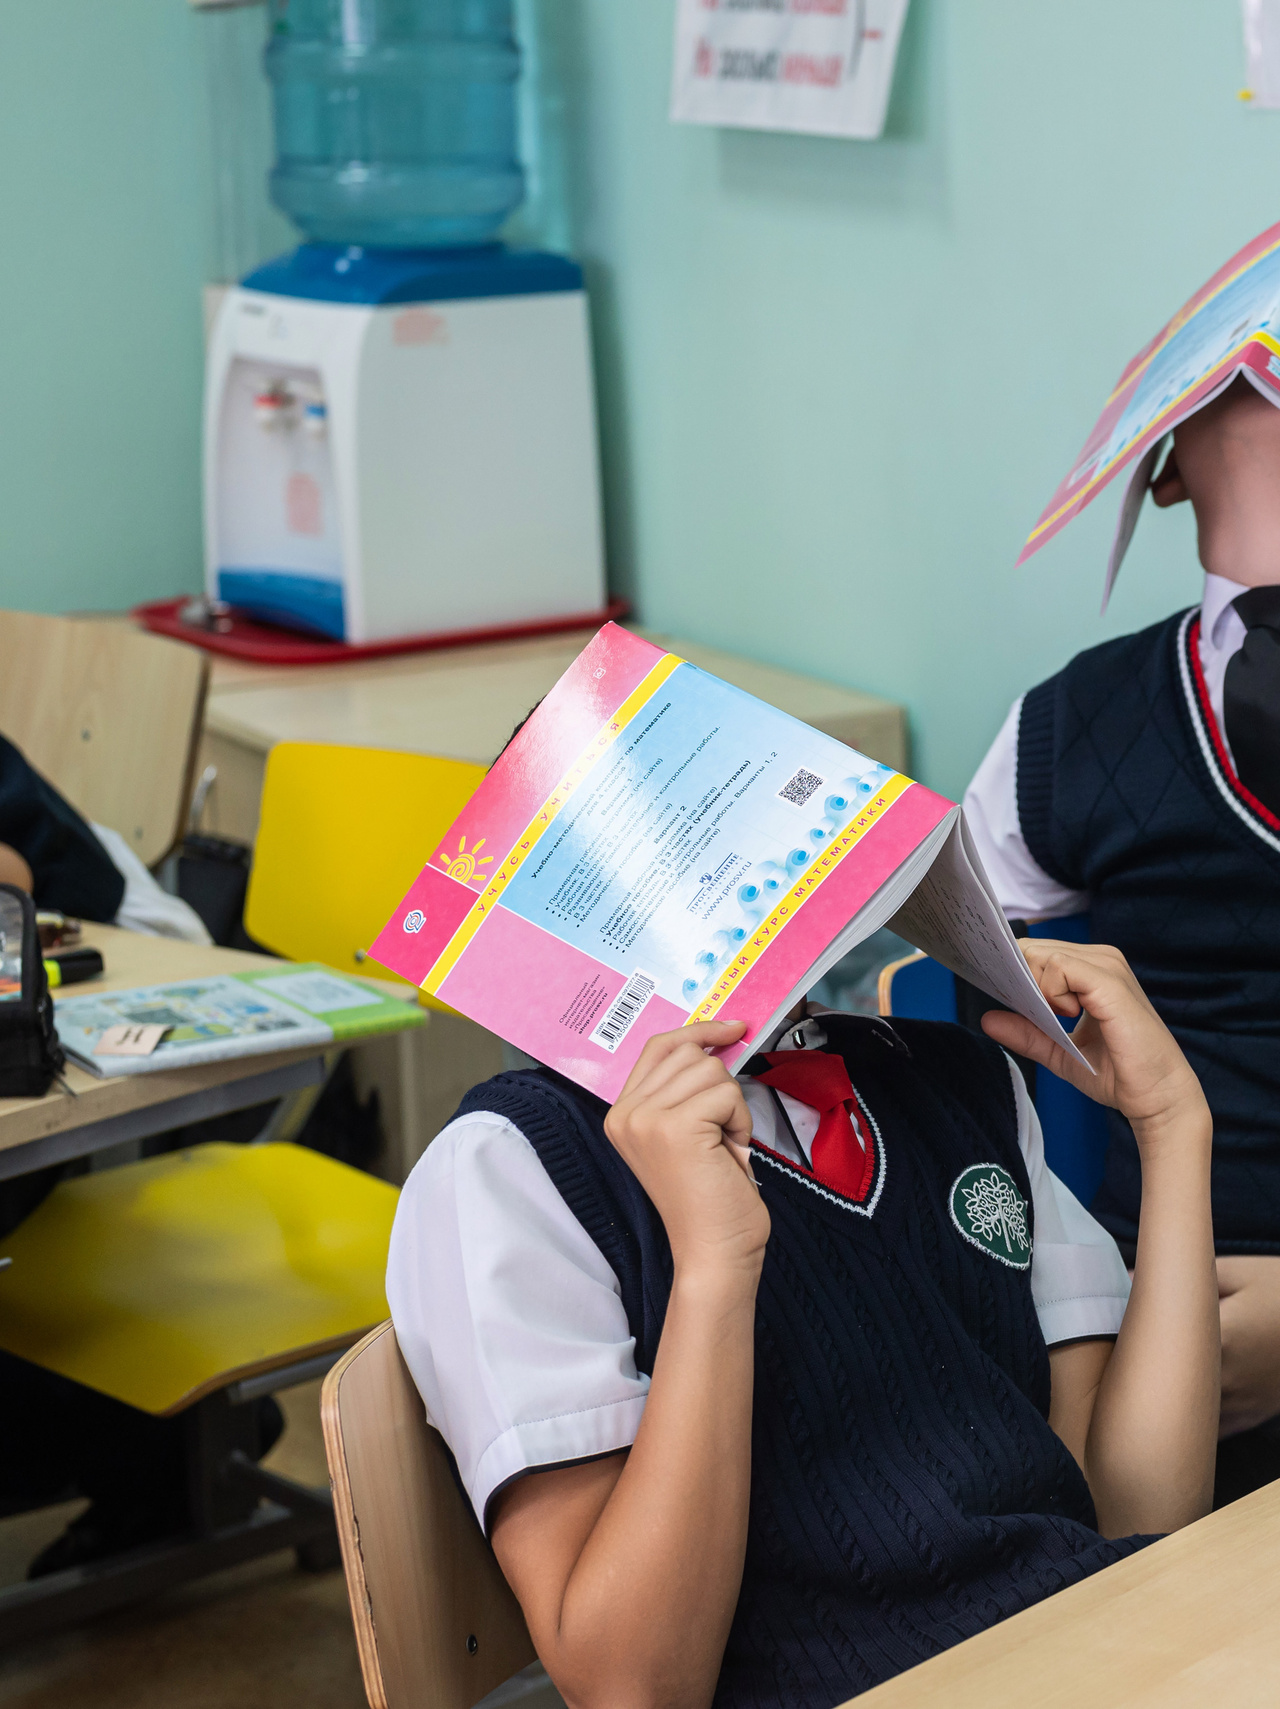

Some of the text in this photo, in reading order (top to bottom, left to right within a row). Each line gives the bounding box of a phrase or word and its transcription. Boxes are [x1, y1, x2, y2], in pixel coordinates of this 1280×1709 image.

[633, 702, 672, 745] математике
[477, 721, 620, 913] УЧУСЬ УЧИТЬСЯ
[548, 863, 581, 905] Примерная
[642, 757, 664, 780] сайте)
[599, 891, 633, 934] Примерная
[695, 785, 718, 809] сайте)
[605, 903, 633, 937] Учебное
[671, 825, 694, 851] частях
[618, 878, 670, 944] Самостоятельные
[710, 798, 736, 827] работы.
[734, 765, 766, 799] Варианты
[689, 853, 740, 913] ПРОСВЕЩЕНИЕ
[752, 905, 791, 947] КУРС
[793, 797, 887, 899] МАТЕМАТИКИ
[560, 881, 586, 912] Рабочая
[579, 870, 620, 922] Методическое
[583, 879, 604, 905] частях
[624, 895, 667, 948] Методическое
[699, 828, 722, 851] сайте)
[701, 860, 754, 921] www.prosv.ru
[611, 909, 637, 941] Рабочая
[578, 992, 609, 1035] shop.prosv.ru
